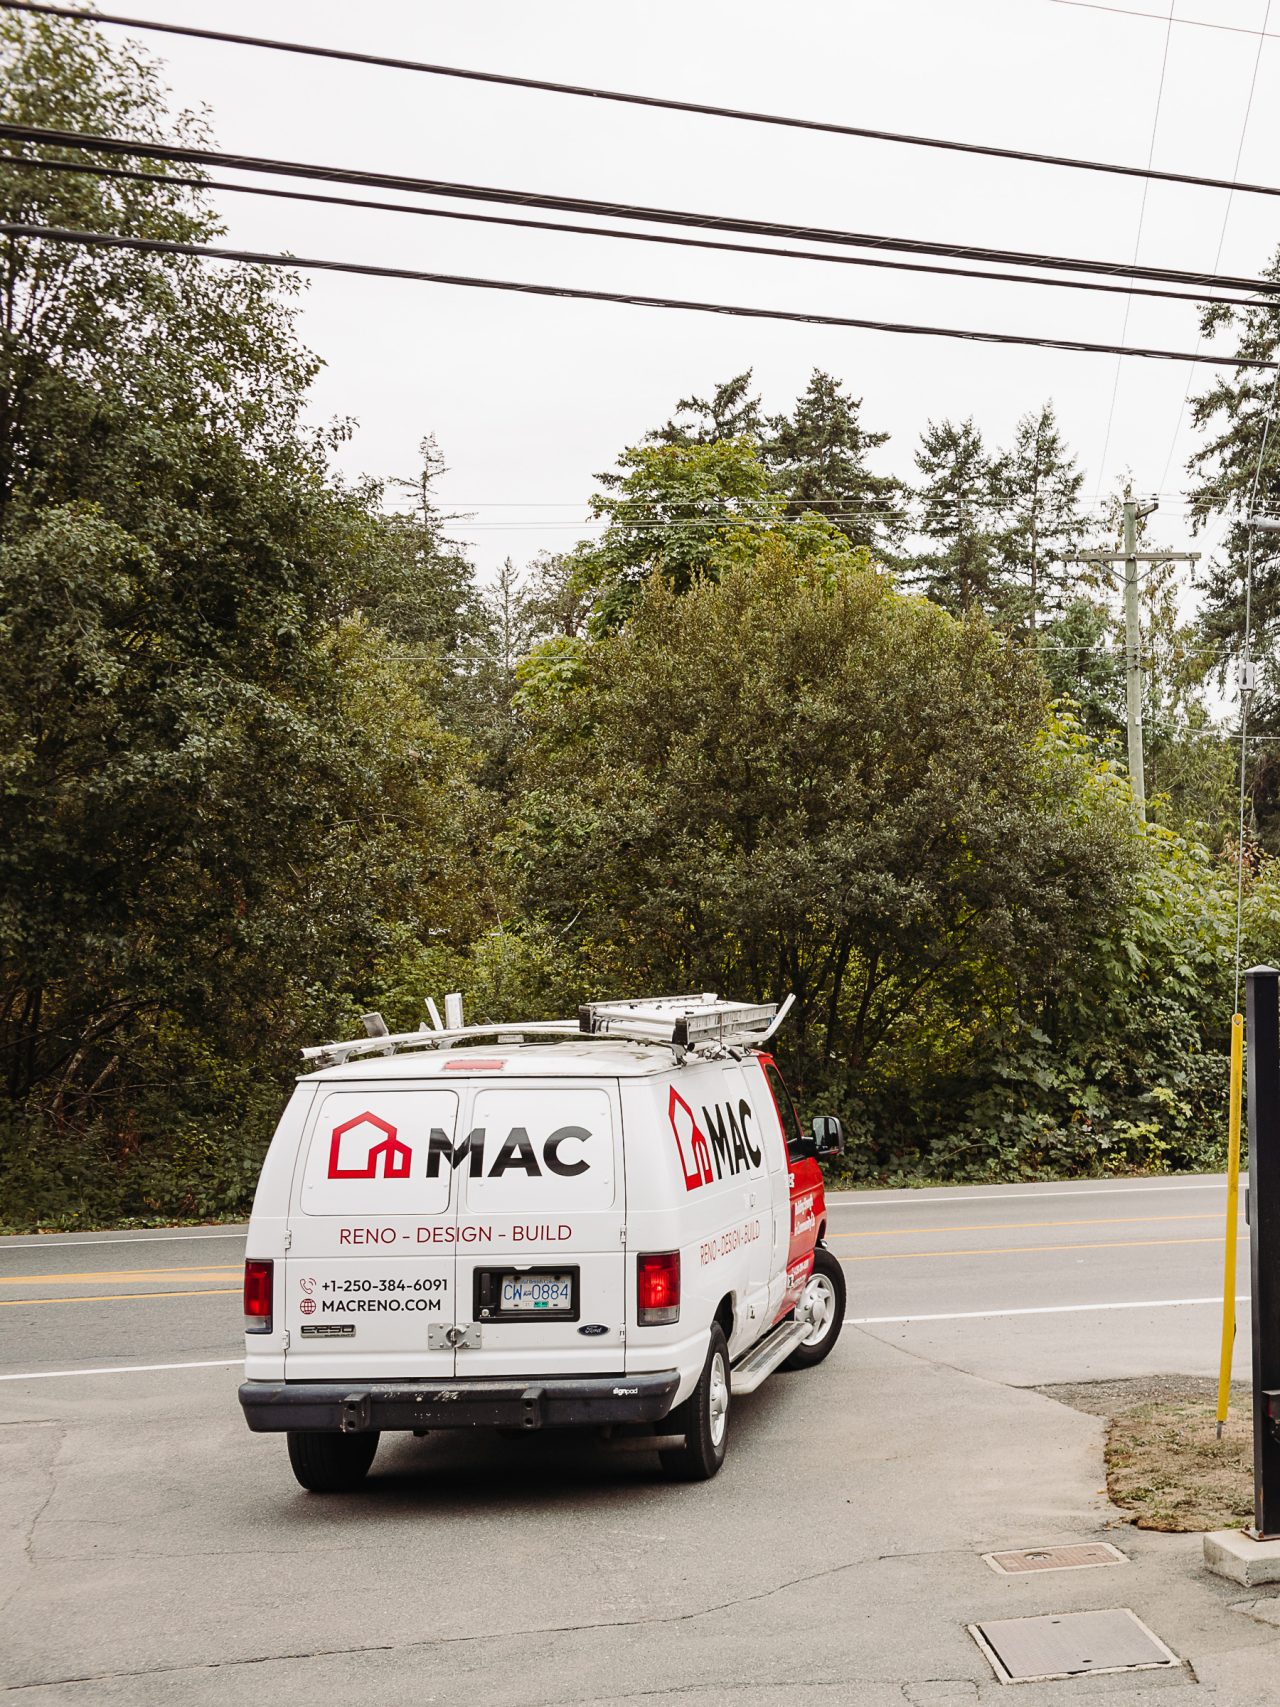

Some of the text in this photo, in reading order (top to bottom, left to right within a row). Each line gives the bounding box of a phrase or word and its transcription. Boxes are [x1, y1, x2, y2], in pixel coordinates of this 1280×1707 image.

[702, 1099, 762, 1179] MAC
[426, 1126, 593, 1179] MAC
[339, 1228, 397, 1245] RENO
[416, 1226, 492, 1243] DESIGN
[512, 1225, 572, 1242] BUILD
[322, 1279, 448, 1292] +1-250-384-6091
[322, 1299, 441, 1313] MACRENO.COM
